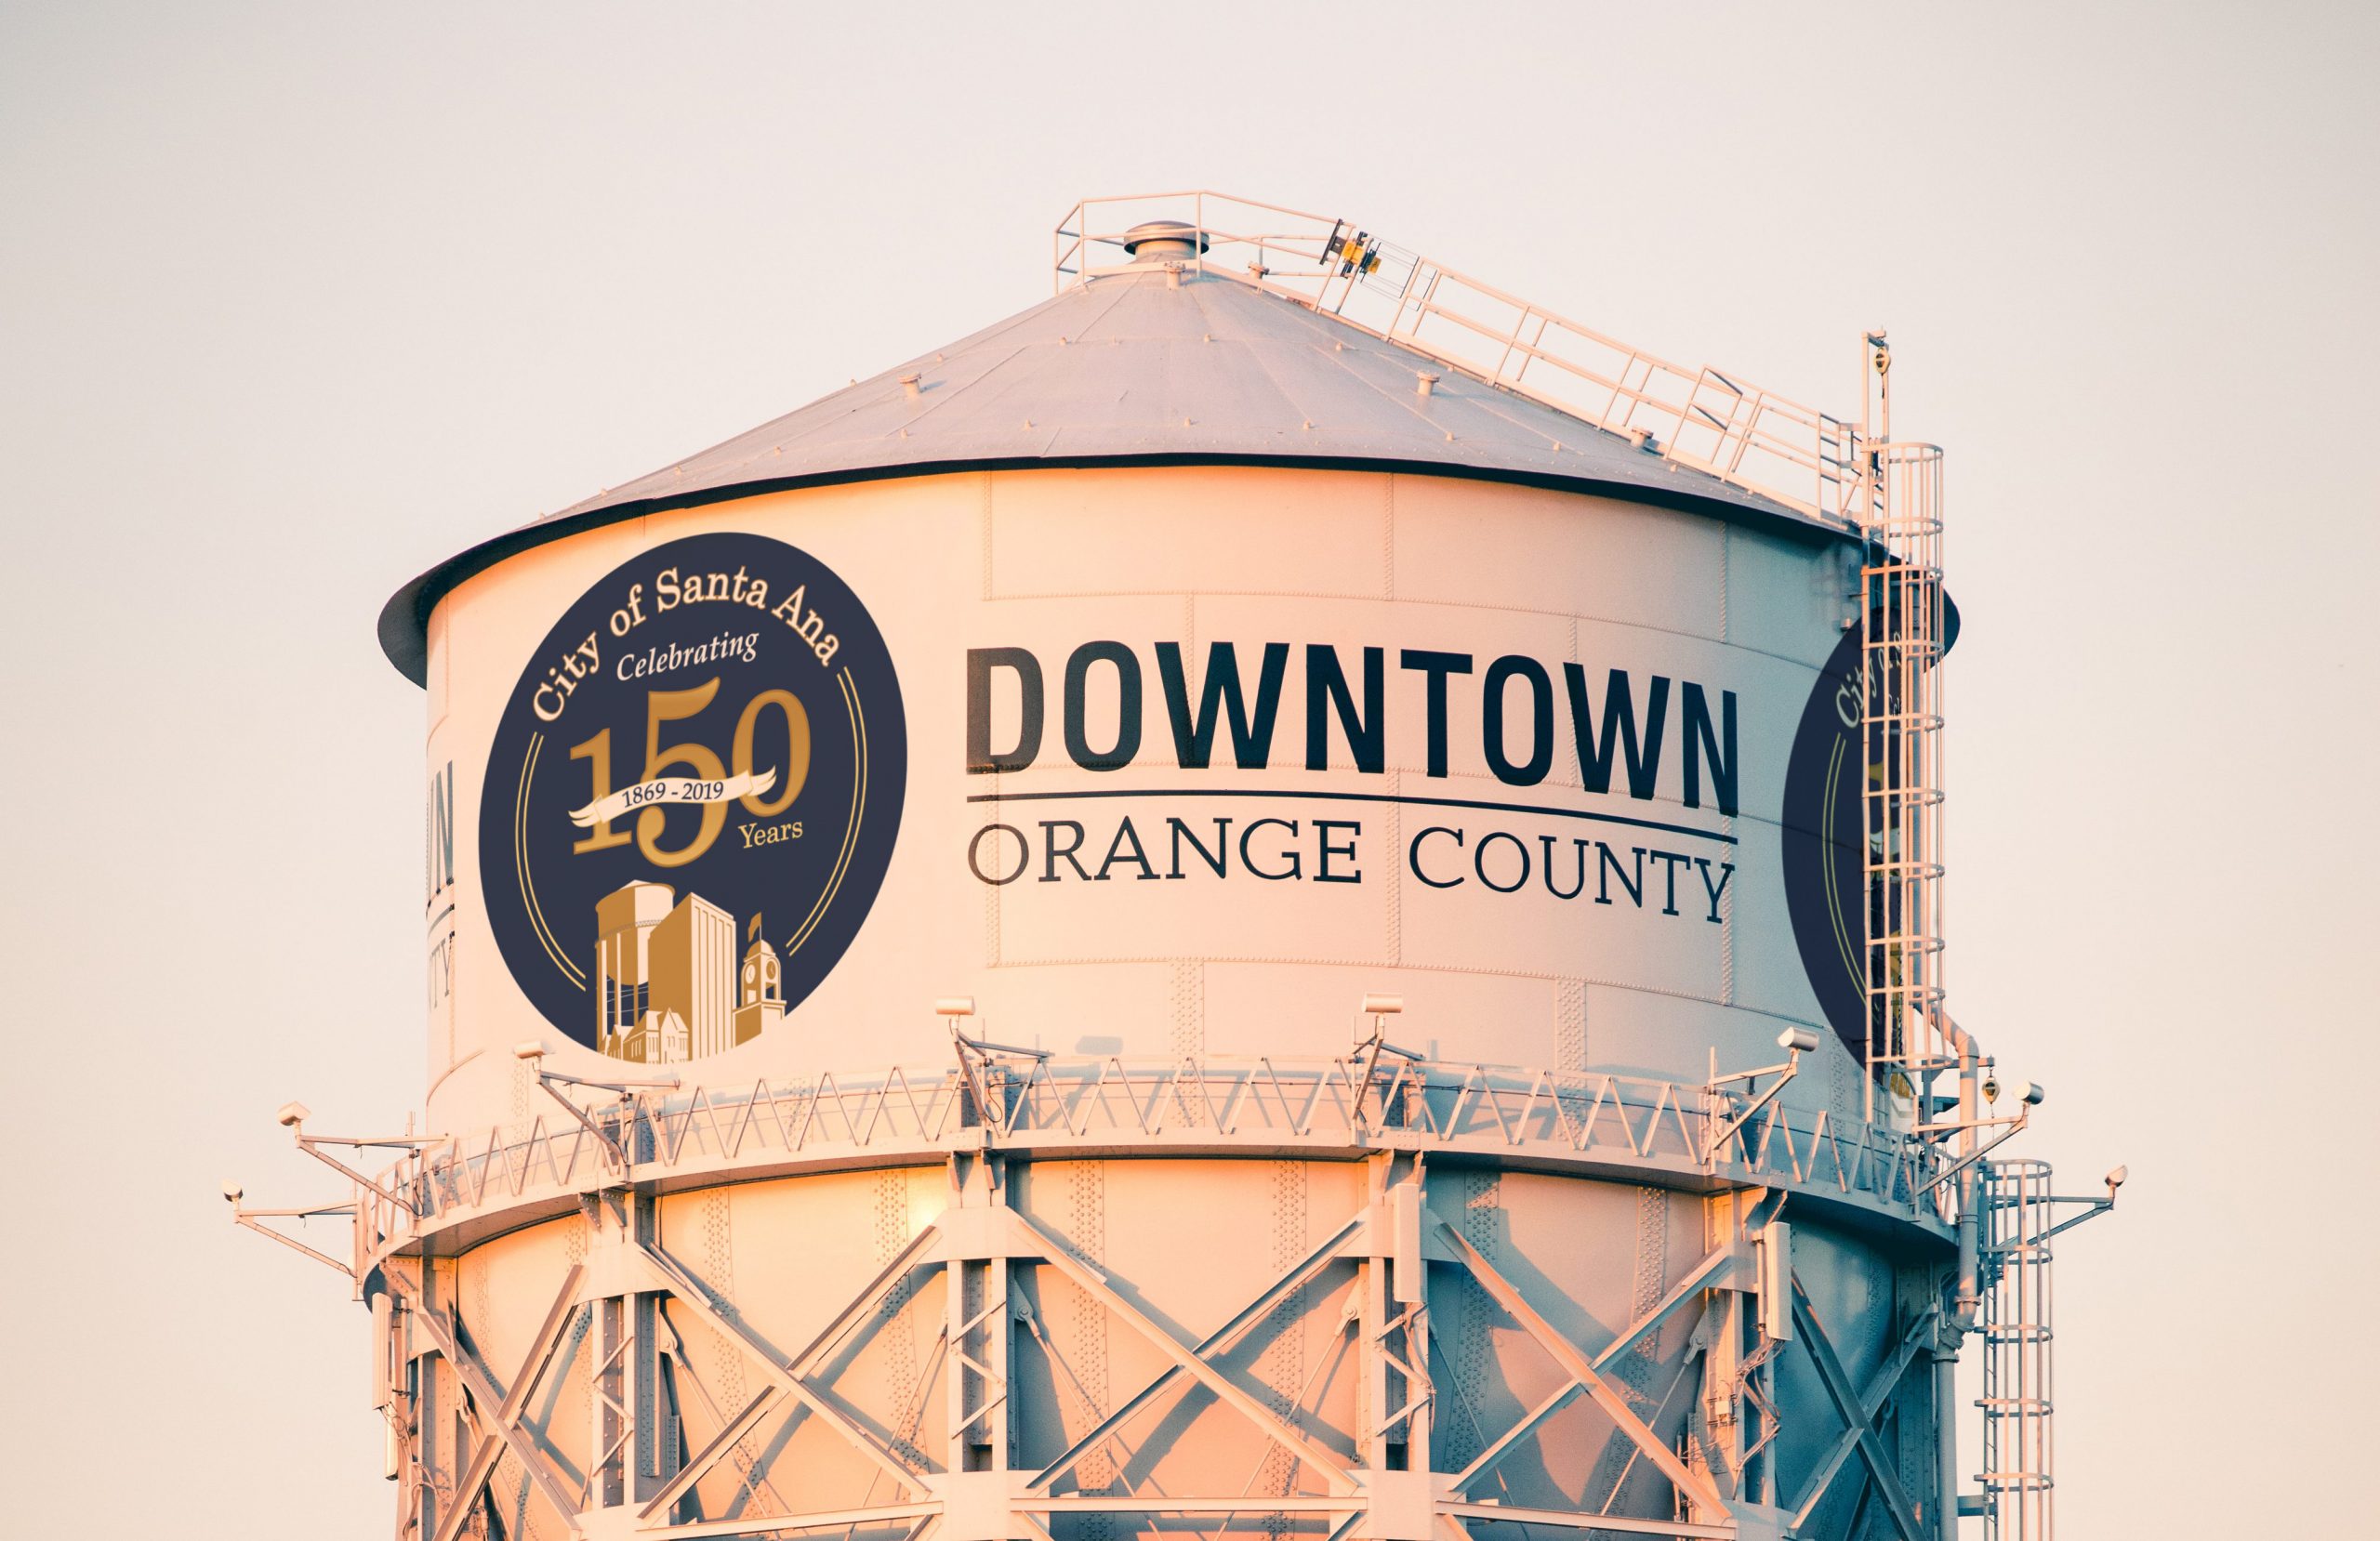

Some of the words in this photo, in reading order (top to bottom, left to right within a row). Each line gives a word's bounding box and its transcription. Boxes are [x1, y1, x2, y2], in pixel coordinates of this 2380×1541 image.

[533, 631, 601, 722] City
[610, 584, 647, 638] of
[656, 566, 769, 613] Santa
[771, 586, 840, 667] Ana
[616, 630, 760, 681] Celebrating
[569, 677, 811, 868] 150
[966, 639, 1739, 819] DOWNTOWN
[621, 782, 666, 808] 1869
[681, 781, 724, 800] 2019
[738, 821, 803, 850] Years
[967, 815, 1363, 886] ORANGE
[1408, 826, 1736, 925] COUNTY
